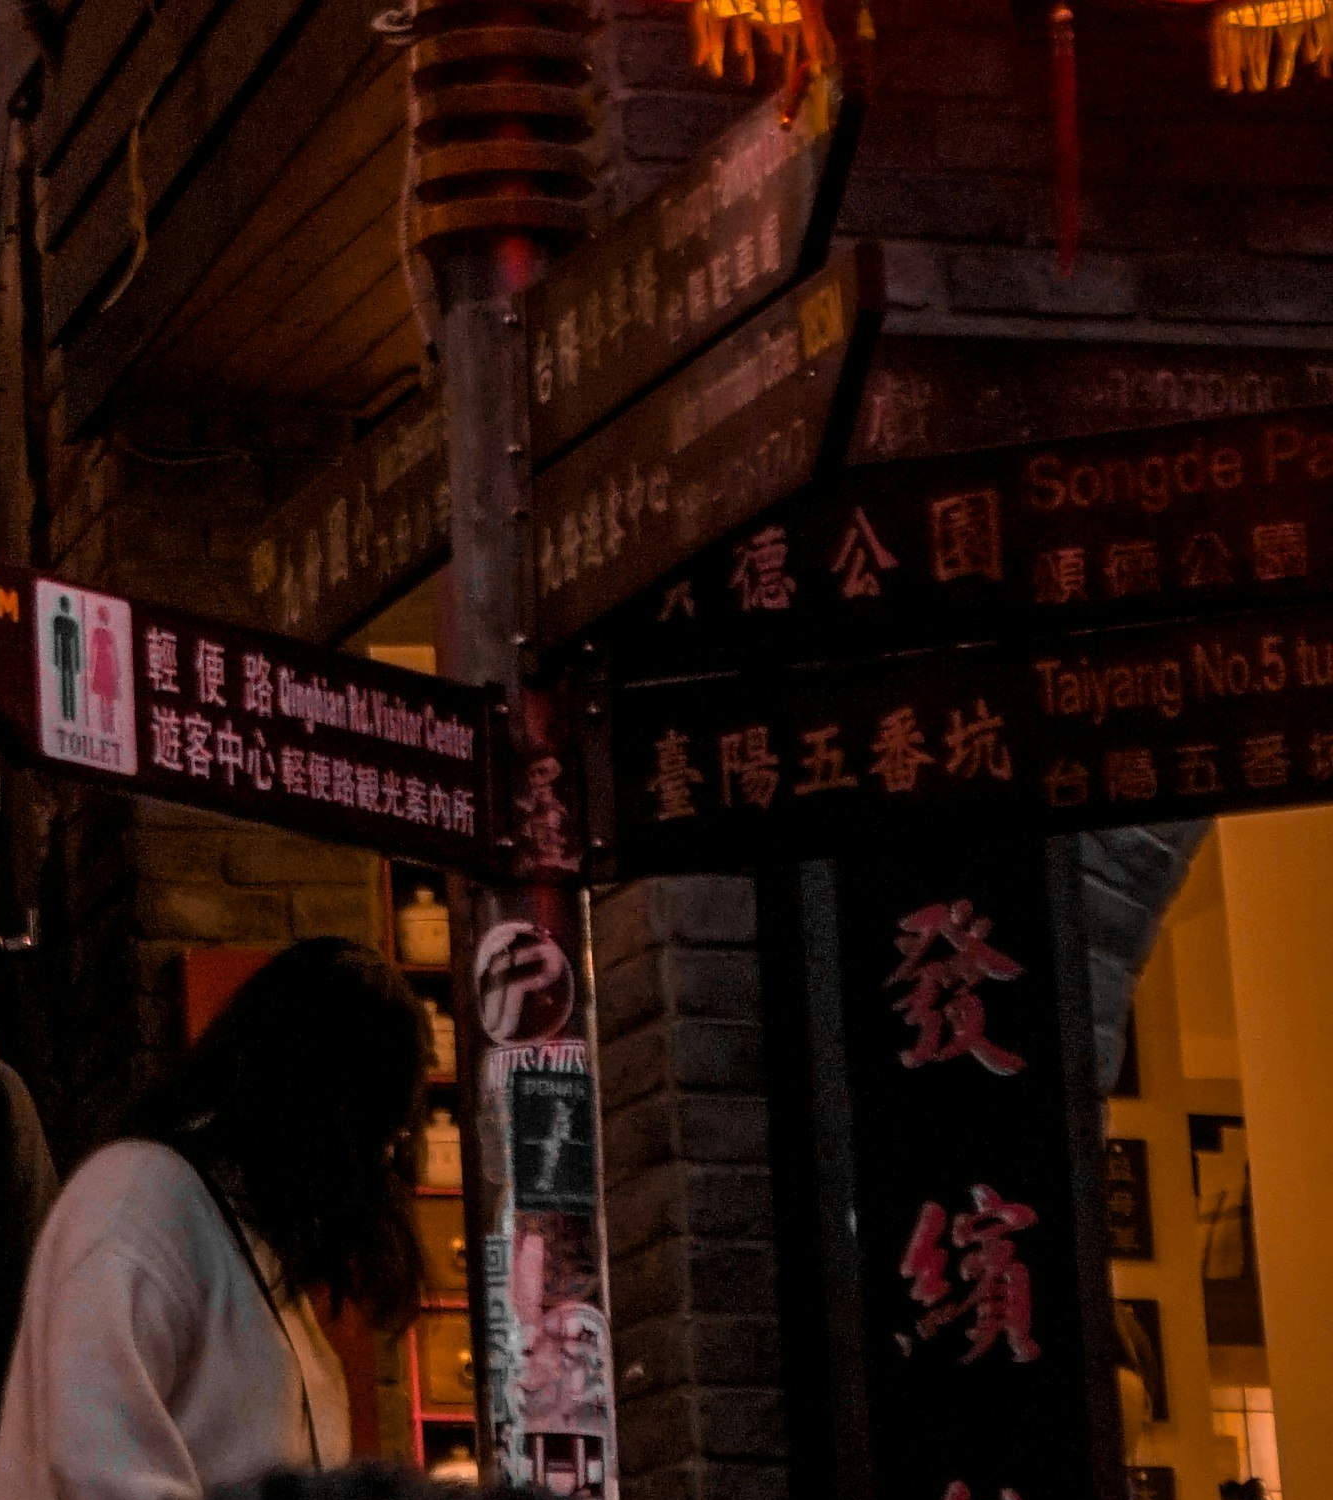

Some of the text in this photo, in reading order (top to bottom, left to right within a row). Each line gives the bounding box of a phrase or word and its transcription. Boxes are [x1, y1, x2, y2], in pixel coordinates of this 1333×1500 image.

[1028, 442, 1243, 512] Songde
[145, 625, 274, 718] 輕便路
[1035, 654, 1182, 725] Taiyang
[56, 727, 122, 766] TOILET
[151, 702, 275, 791] 遊客中心
[423, 704, 475, 761] Center
[646, 698, 1013, 823] 臺陽五番坑
